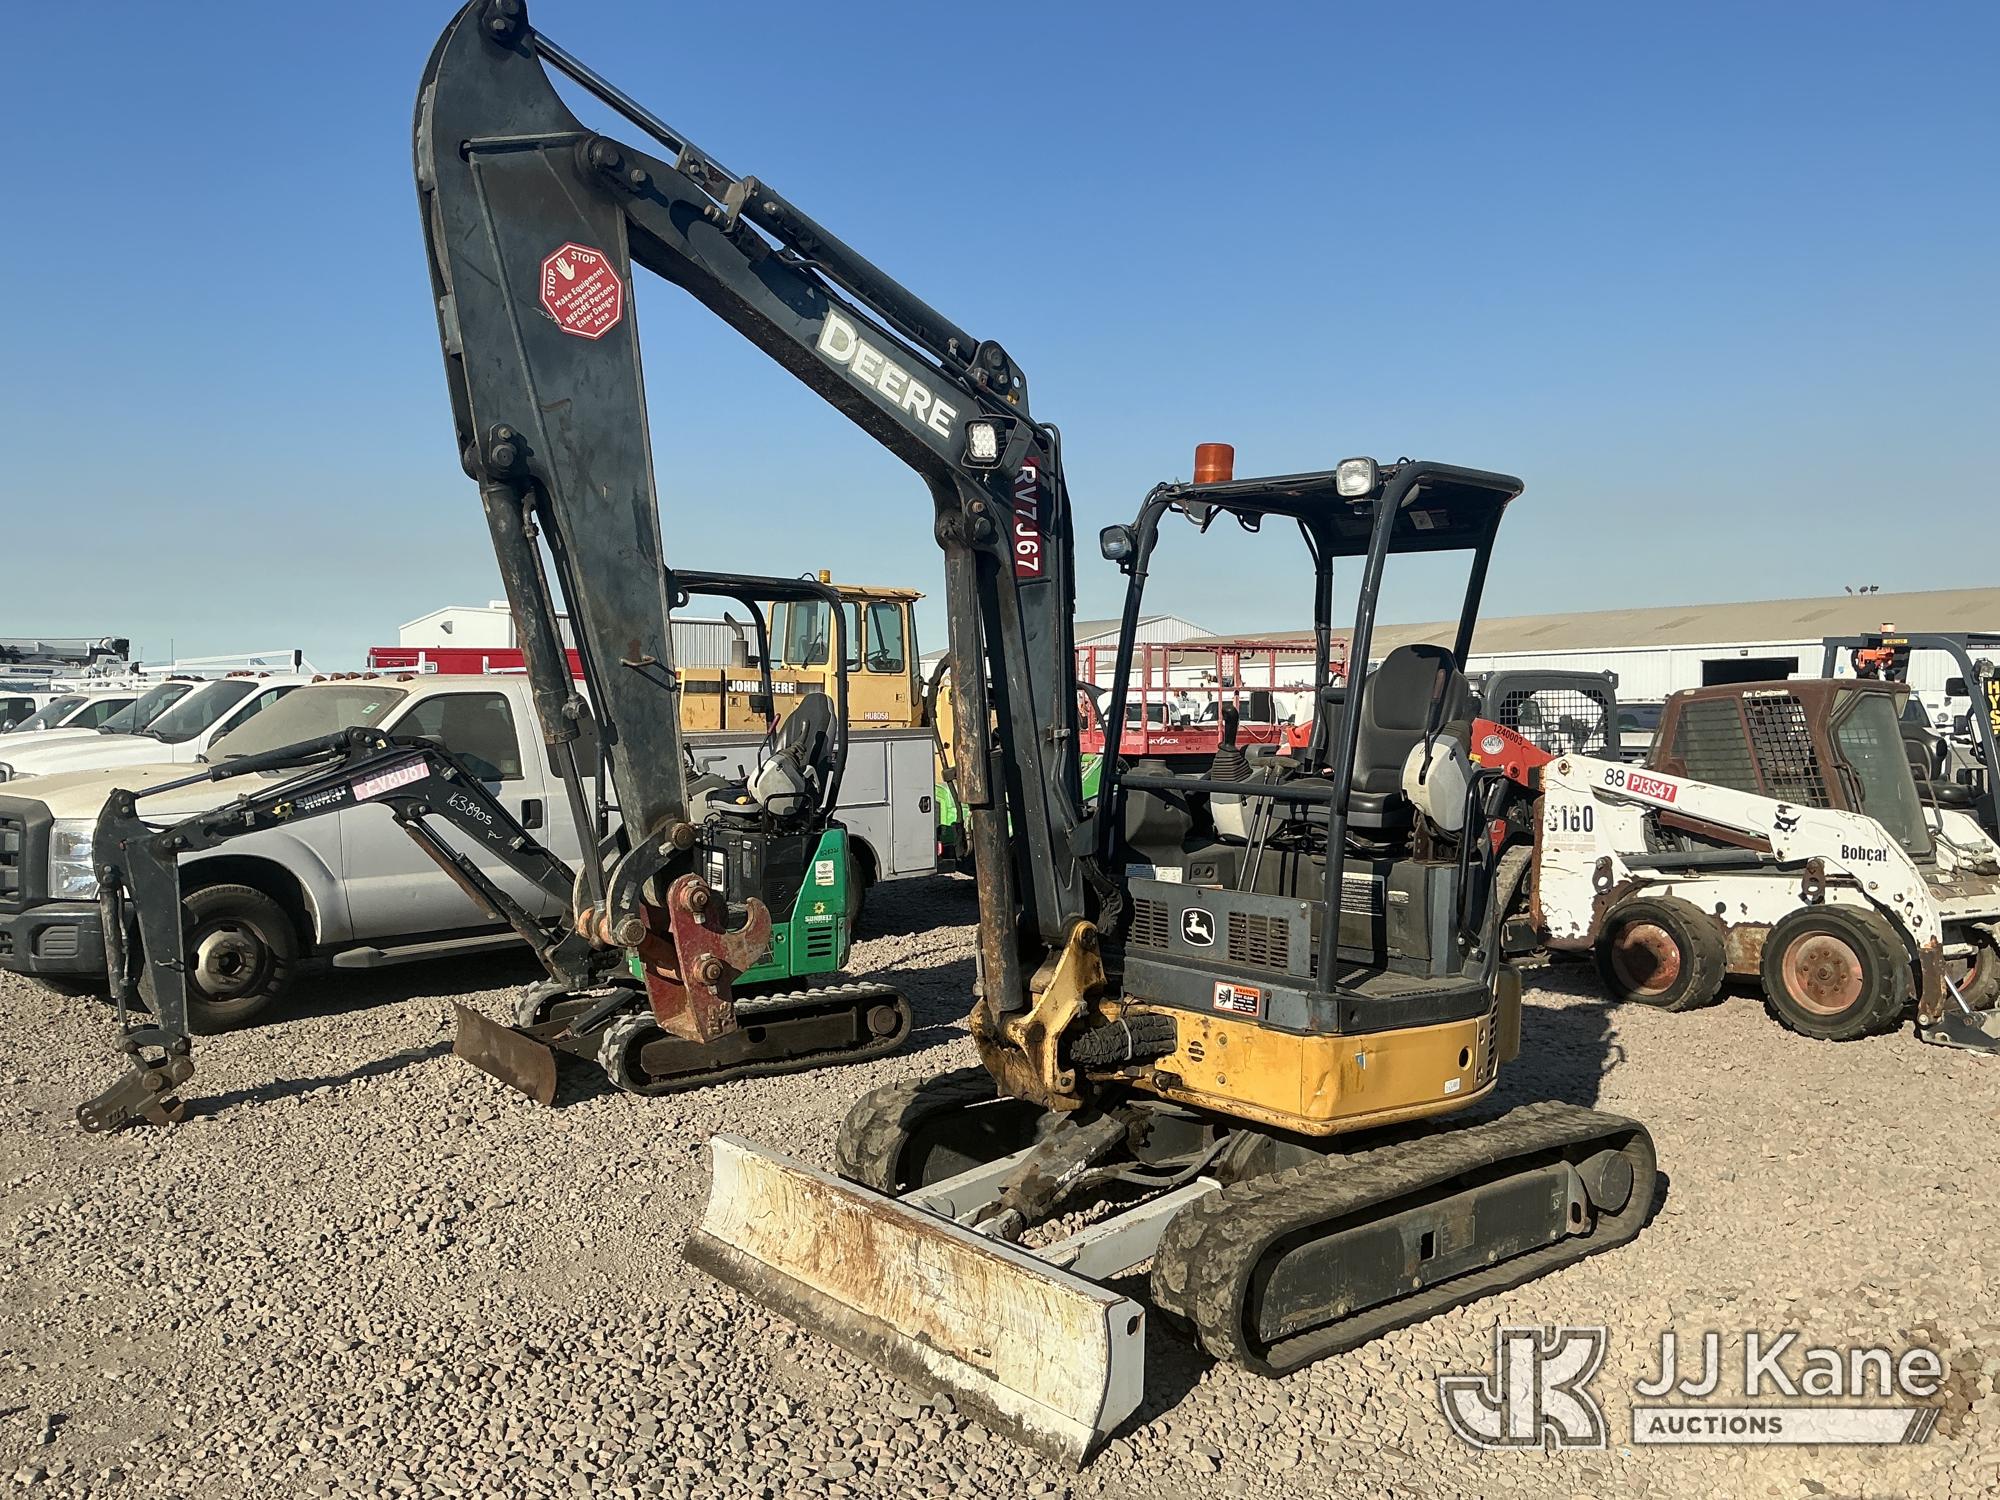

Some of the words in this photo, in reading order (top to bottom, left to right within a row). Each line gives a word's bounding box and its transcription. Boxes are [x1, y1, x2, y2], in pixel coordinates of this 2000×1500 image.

[571, 251, 597, 265] STOP
[547, 269, 557, 297] STOP
[554, 292, 573, 309] Make
[571, 267, 605, 296] Equipment
[568, 281, 602, 310] Inoperable
[565, 302, 592, 325] BEFORE
[589, 283, 616, 305] Persons
[576, 312, 594, 328] Enter
[592, 295, 616, 316] Danger
[594, 312, 610, 327] Area
[820, 314, 957, 439] DEERE
[1015, 466, 1039, 572] RV7J67
[728, 681, 759, 693] JOHN
[761, 682, 795, 694] EERE
[1493, 723, 1523, 746] 1240003
[1604, 767, 1626, 787] 88
[1630, 775, 1675, 800] PJ3S47
[1841, 844, 1888, 862] Bobcat
